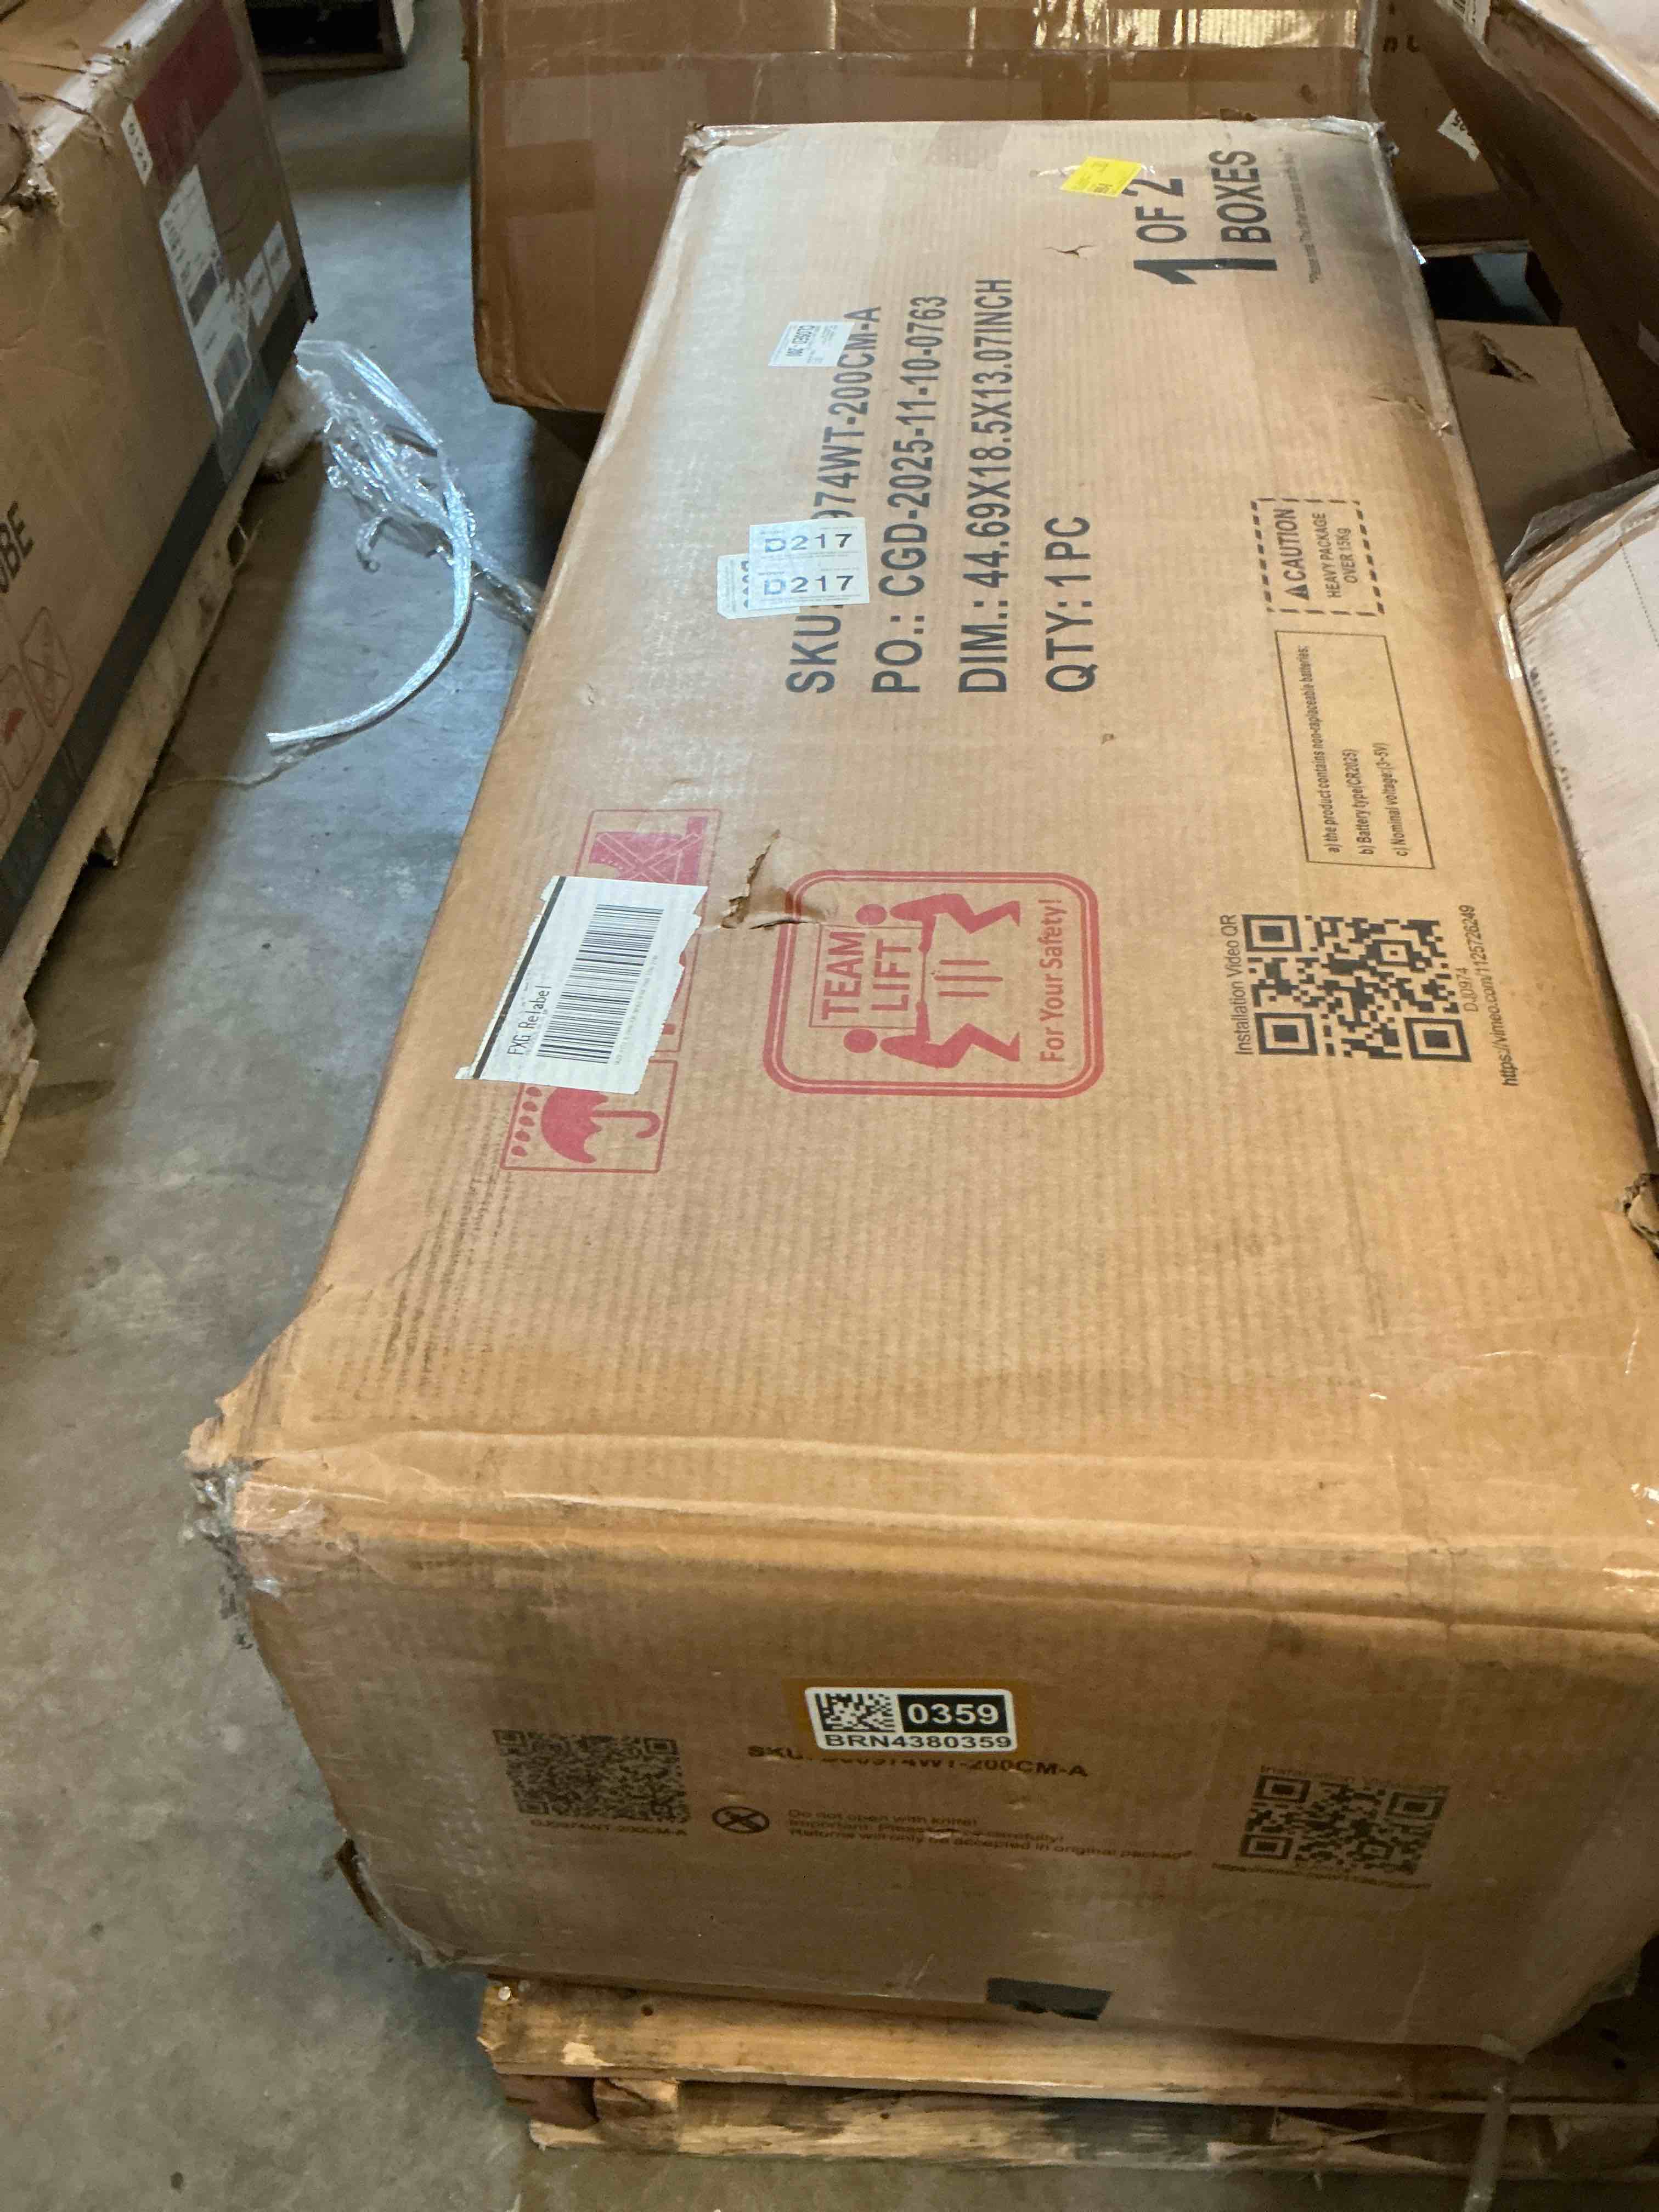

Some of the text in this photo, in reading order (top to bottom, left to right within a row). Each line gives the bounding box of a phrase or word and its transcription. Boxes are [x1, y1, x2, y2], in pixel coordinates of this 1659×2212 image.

[1209, 150, 1272, 243] BOXES
[1122, 178, 1277, 284] 1 OF 2
[871, 296, 948, 693] PO.: CGD-2025-11-10-0763
[958, 278, 1013, 693] DIM.: 44.69X18.5X13.07INCH
[764, 533, 853, 552] D217
[1273, 509, 1306, 581] CAUTION
[1312, 512, 1342, 599] HEAVY PACKAGE
[764, 574, 854, 595] D217
[1340, 555, 1358, 584] OVER
[1045, 601, 1098, 692] QTY:
[1311, 751, 1330, 789] contains
[1317, 790, 1339, 826] product
[1356, 810, 1372, 843] Battery
[1384, 806, 1406, 845] Nominal
[1321, 826, 1338, 842] the
[823, 931, 865, 1020] TEAM
[871, 938, 911, 1012] LIFT
[1038, 898, 1068, 1063] For Your Safety!
[1220, 914, 1254, 1056] Installation Video QR
[517, 985, 552, 1029] Relabel
[506, 1035, 532, 1055] FXG
[907, 1703, 999, 1725] 0359
[825, 1734, 1012, 1748] BRN4380359
